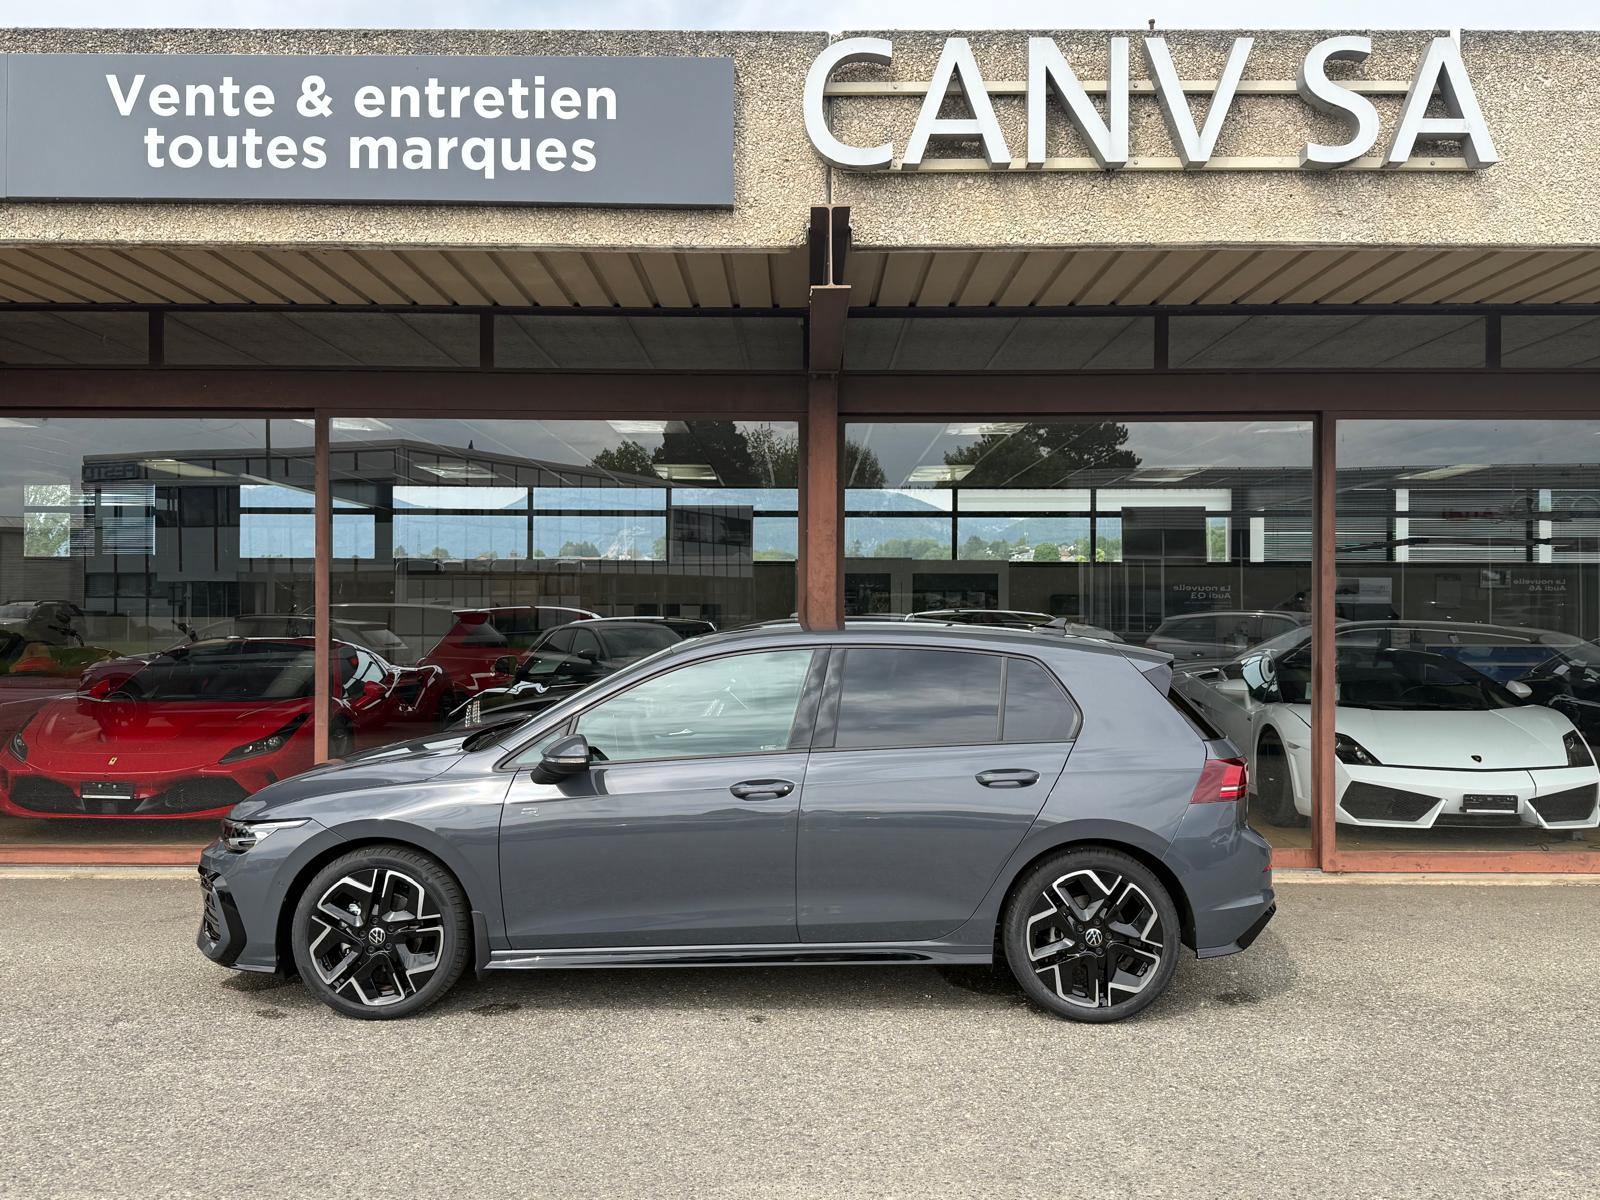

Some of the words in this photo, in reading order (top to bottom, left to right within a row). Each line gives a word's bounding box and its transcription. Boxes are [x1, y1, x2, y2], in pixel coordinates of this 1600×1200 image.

[106, 74, 275, 118] Vente
[297, 75, 333, 118] &
[354, 76, 618, 120] entretien
[804, 36, 1254, 170] CANV
[1299, 36, 1498, 170] SA
[144, 126, 327, 170] toutes
[349, 133, 597, 180] marques
